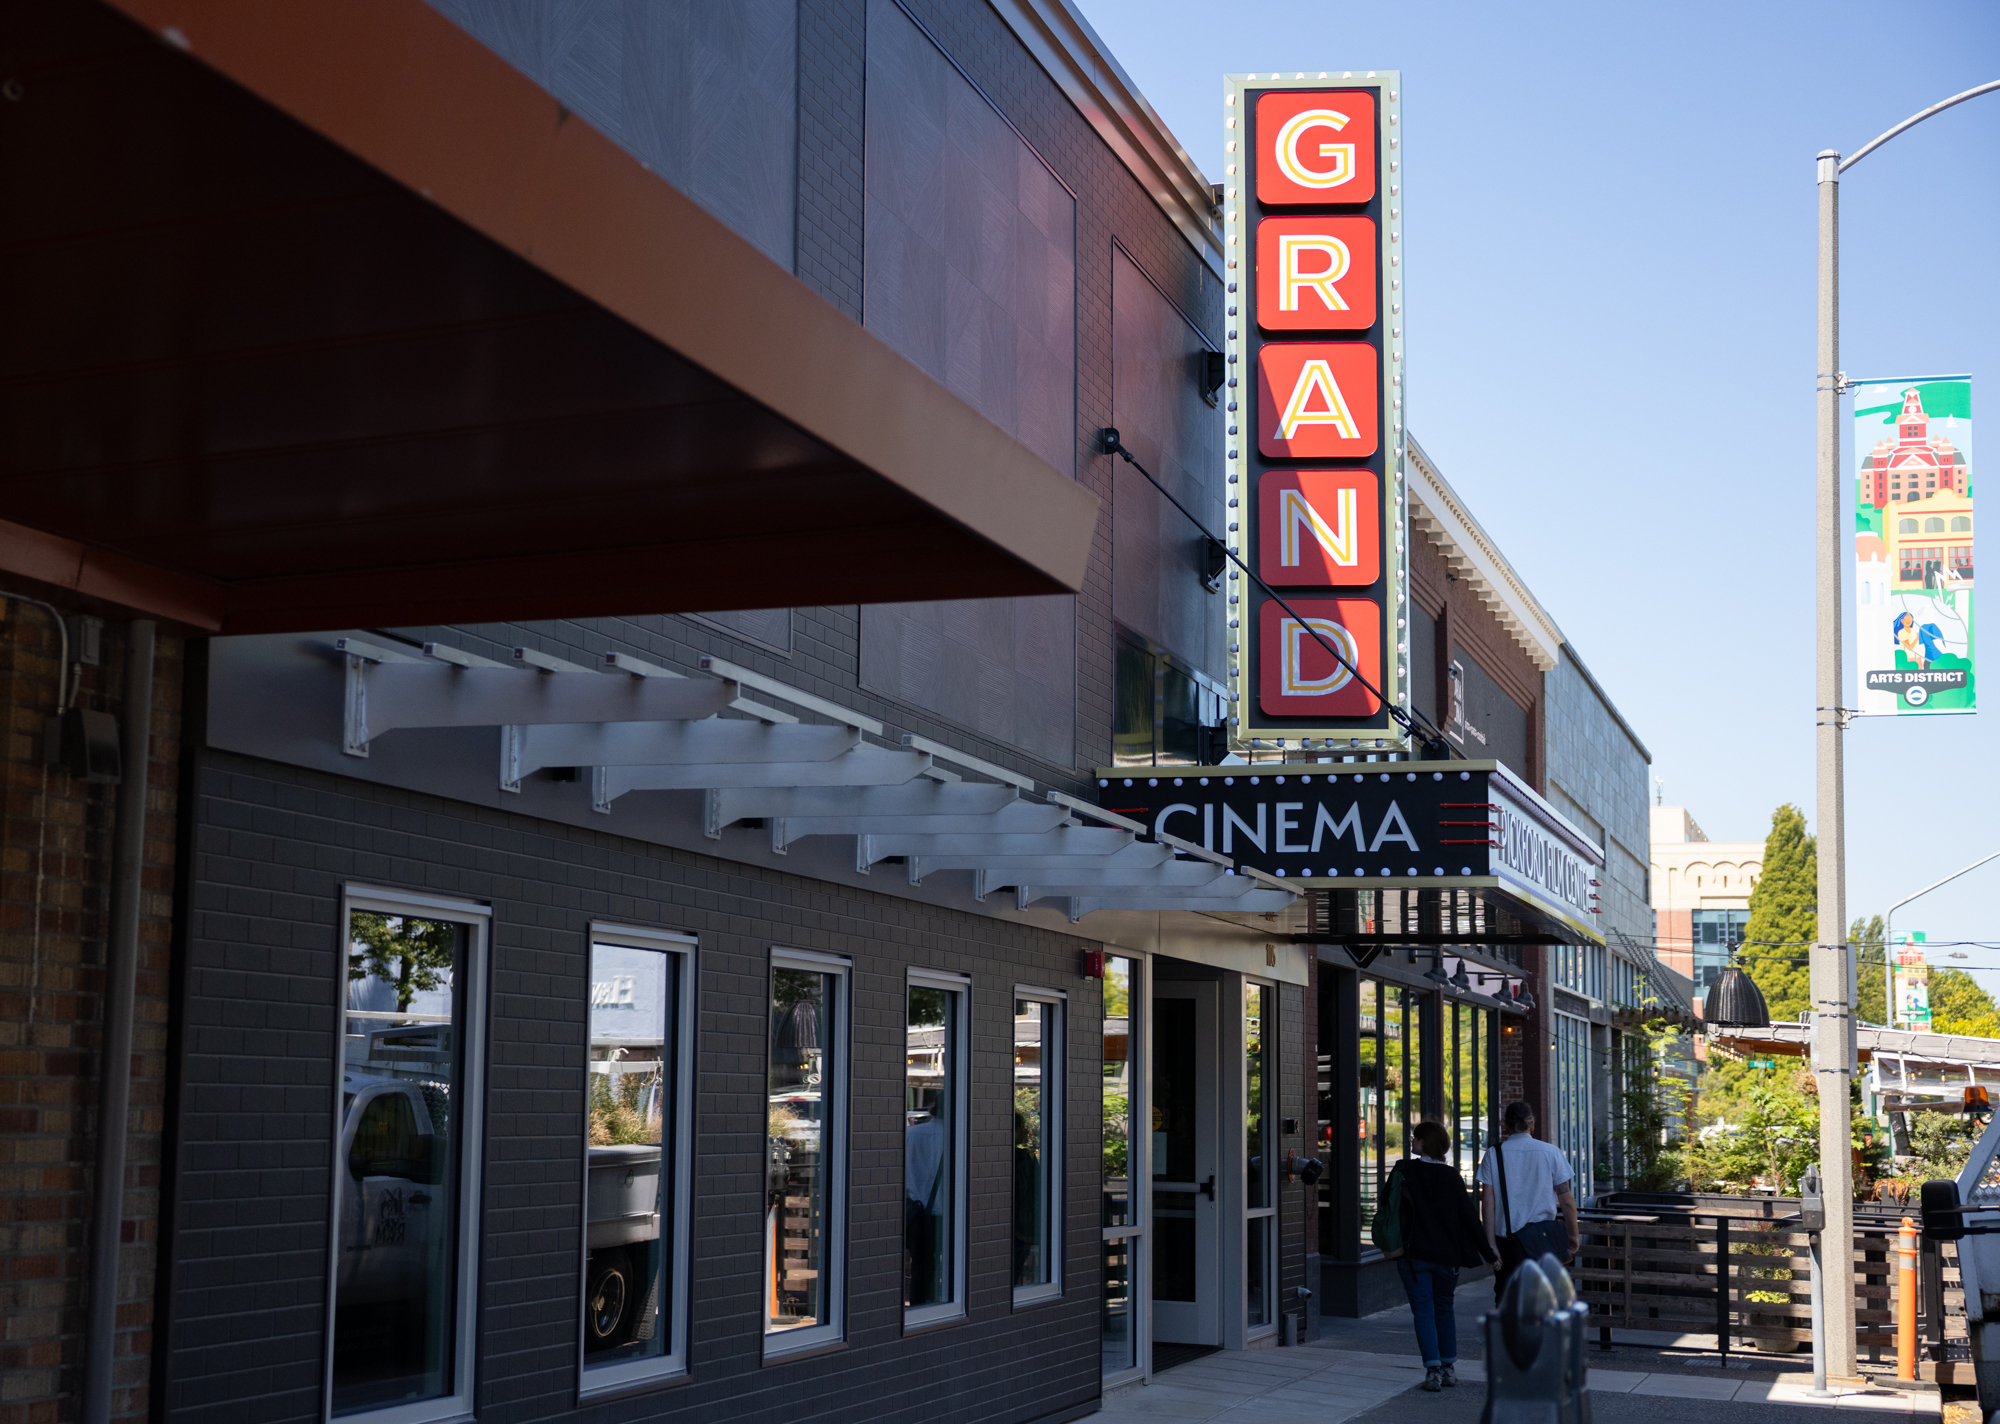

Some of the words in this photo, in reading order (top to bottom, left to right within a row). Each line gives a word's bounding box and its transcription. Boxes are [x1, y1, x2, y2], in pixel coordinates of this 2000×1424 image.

[1273, 108, 1362, 697] GRAND
[1869, 673, 1903, 684] ARTS
[1904, 671, 1964, 683] DISTRICT
[1154, 800, 1421, 855] CINEMA
[1498, 806, 1545, 884] PICKFORD
[1544, 840, 1563, 898] FILM
